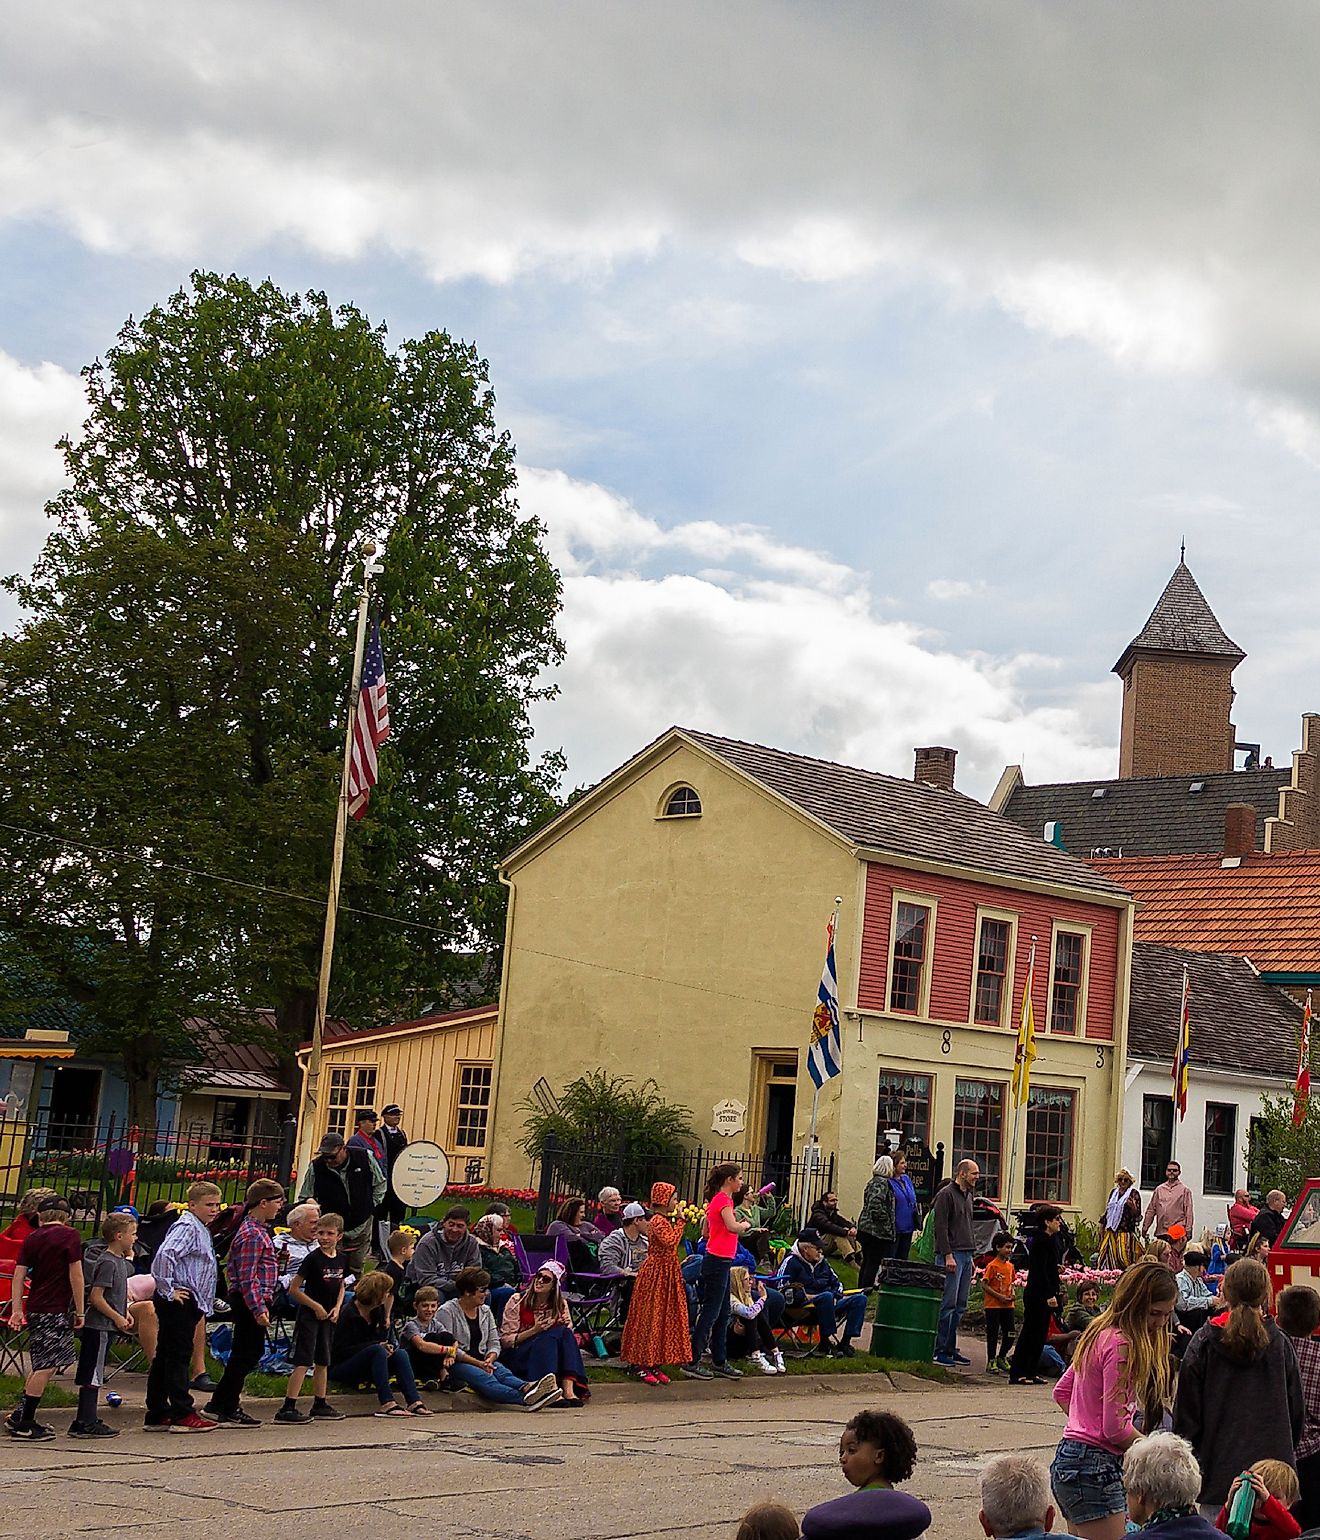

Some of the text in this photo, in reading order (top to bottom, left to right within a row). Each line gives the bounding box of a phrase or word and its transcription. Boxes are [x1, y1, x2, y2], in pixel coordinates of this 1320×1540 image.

[941, 1029, 951, 1054] 8
[1096, 1045, 1105, 1069] 3
[719, 1115, 737, 1123] STORE
[906, 1144, 922, 1157] Pella
[906, 1157, 930, 1171] torical
